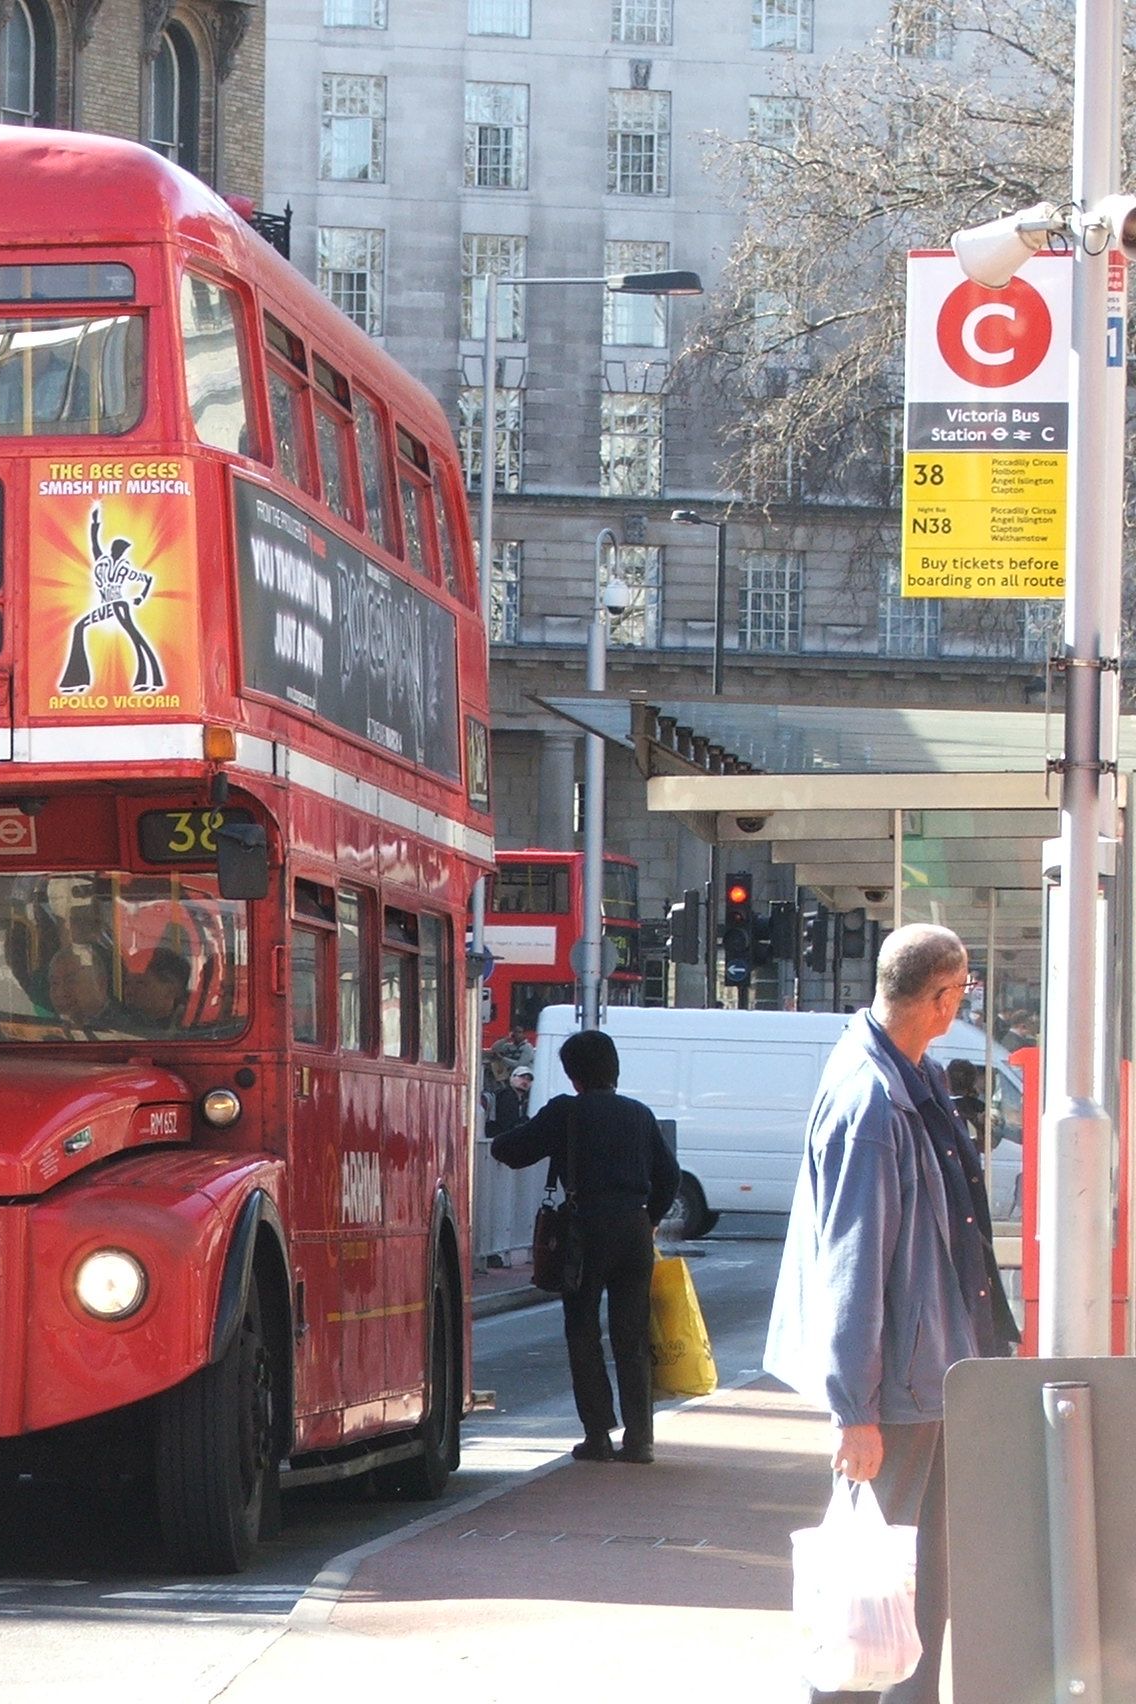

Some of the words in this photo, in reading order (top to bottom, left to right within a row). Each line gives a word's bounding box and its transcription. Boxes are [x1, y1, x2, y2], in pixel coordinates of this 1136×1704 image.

[960, 302, 1016, 366] C
[946, 408, 1007, 423] Victoria
[1012, 408, 1040, 423] Bus
[931, 427, 987, 442] Station
[1041, 427, 1056, 442] C
[991, 458, 1030, 468] Piccadilly
[1032, 458, 1058, 467] Circus
[50, 464, 83, 479] THE
[90, 463, 124, 479] BEE
[913, 464, 944, 486] 38
[991, 468, 1026, 476] Holborn
[39, 480, 92, 495] SMASH
[98, 480, 121, 495] HIT
[126, 480, 191, 496] MUSICAL
[991, 477, 1015, 487] Angel
[1017, 477, 1054, 486] Islington
[991, 486, 1024, 496] Clapton
[990, 507, 1029, 517] Piccadilly
[1031, 507, 1057, 515] Circus
[912, 518, 952, 534] N38
[990, 516, 1014, 526] Angel
[1017, 516, 1053, 525] Islington
[990, 525, 1024, 535] Clapton
[991, 535, 1048, 543] Walthamstow
[921, 557, 947, 572] Buy
[953, 556, 1004, 570] tickets
[1009, 556, 1059, 570] before
[908, 574, 972, 589] boarding
[977, 576, 996, 587] on
[1001, 574, 1019, 587] all
[1024, 575, 1067, 587] route
[49, 695, 108, 709] APOLLO
[113, 695, 180, 709] VICTORIA
[165, 812, 225, 852] 38
[150, 1112, 163, 1136] RM
[164, 1111, 178, 1134] 652
[341, 1151, 383, 1224] ARRIVA
